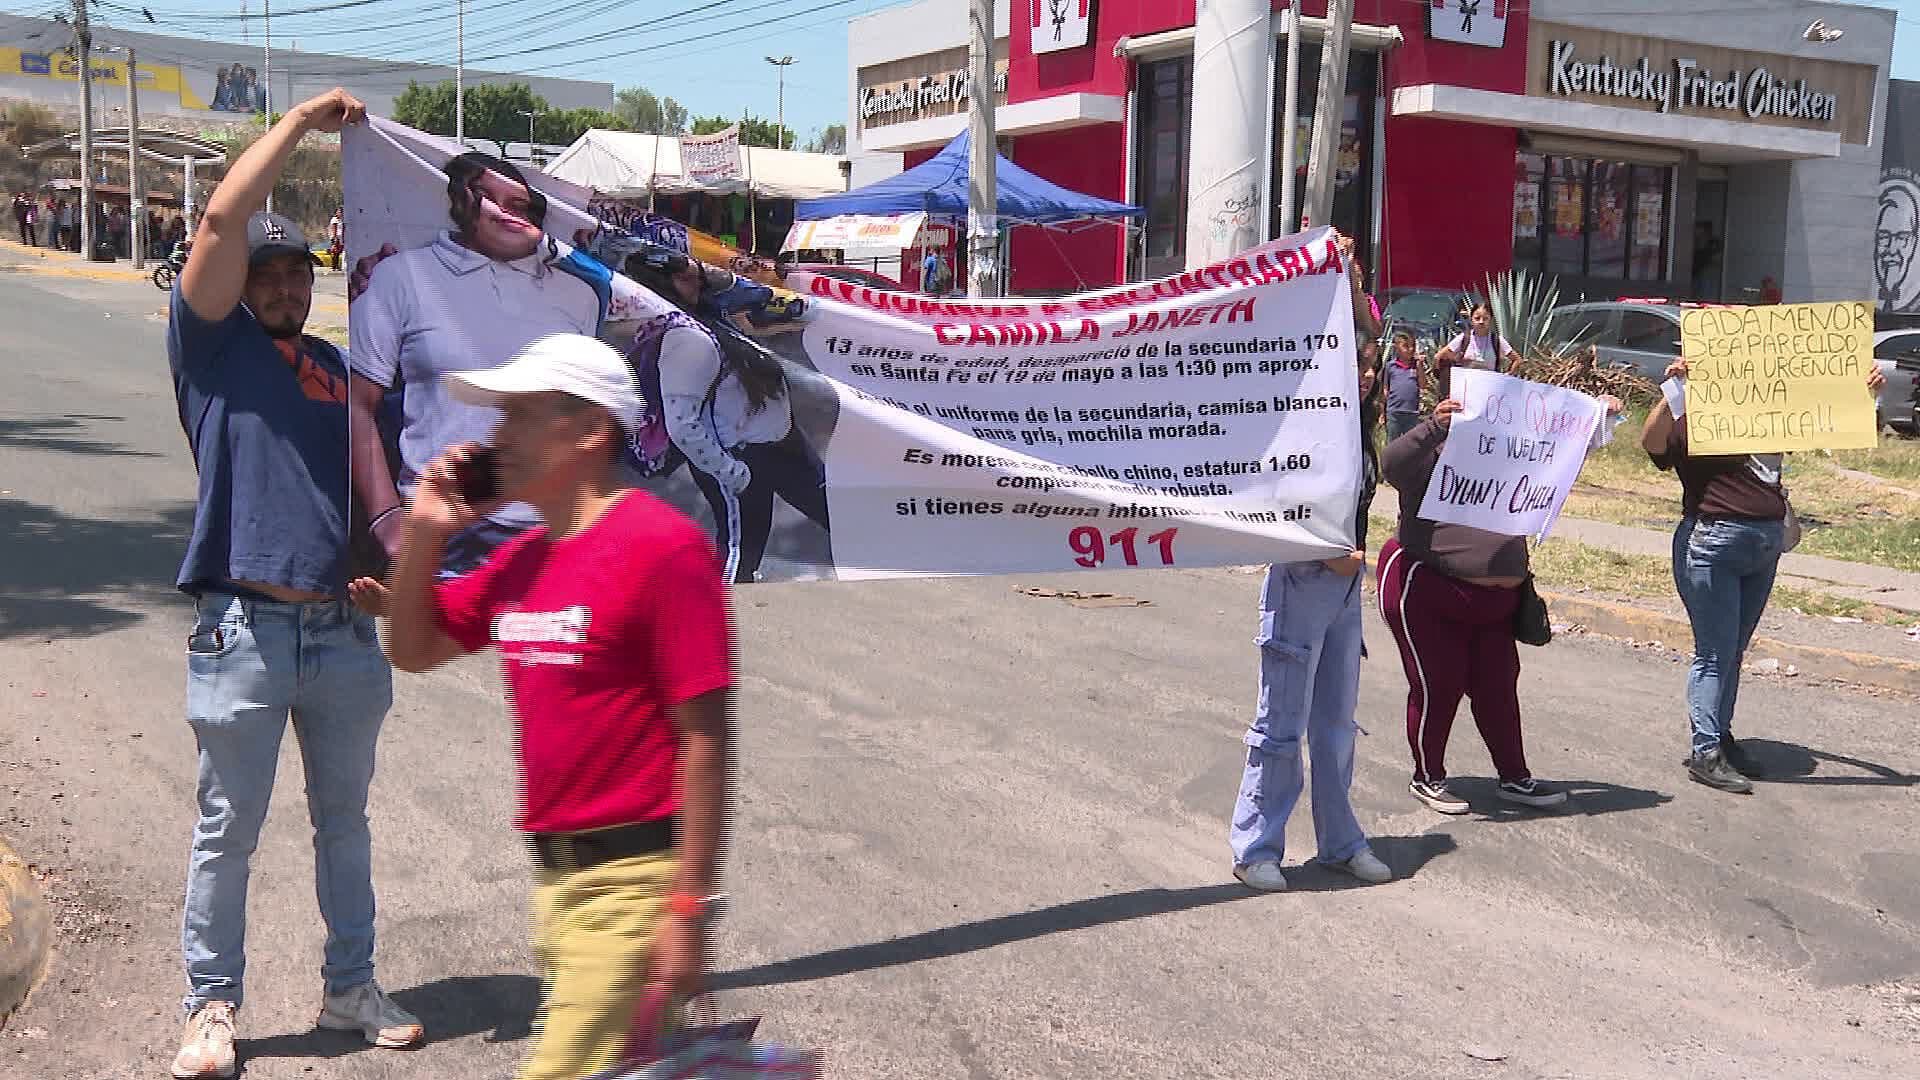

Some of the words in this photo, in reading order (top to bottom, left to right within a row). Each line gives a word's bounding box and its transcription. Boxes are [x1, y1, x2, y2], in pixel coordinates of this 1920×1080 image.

[1550, 40, 1671, 114] Kentucky
[1676, 59, 1741, 109] Fried
[1744, 66, 1837, 120] Chicken
[860, 83, 917, 120] Kentucky
[918, 75, 951, 110] Fried
[933, 319, 1101, 348] CAMILA
[1112, 297, 1256, 338] JANETH
[1682, 308, 1761, 336] CADA
[1770, 303, 1867, 332] MENOR
[825, 337, 853, 354] 13
[919, 352, 949, 364] de
[1135, 342, 1158, 358] de
[1165, 341, 1181, 356] la
[1188, 337, 1297, 356] secundaria
[1303, 334, 1339, 350] 170
[1683, 334, 1858, 358] DESAPARECIDO
[850, 363, 876, 379] en
[879, 362, 939, 383] Santa
[945, 368, 971, 384] Fe
[979, 368, 996, 384] el
[1031, 368, 1056, 384] de
[1062, 364, 1115, 384] mayo
[1121, 364, 1133, 380] a
[1139, 362, 1169, 378] las
[1175, 360, 1217, 376] 1:30
[1222, 361, 1252, 379] pm
[1258, 359, 1320, 376] aprox.
[1686, 360, 1710, 381] ES
[1716, 360, 1755, 380] UNA
[1763, 355, 1859, 379] URGENCIA
[1689, 381, 1722, 405] NO
[1731, 379, 1788, 405] UNA
[935, 403, 1019, 424] uniforme
[1025, 406, 1049, 423] de
[1055, 406, 1073, 421] la
[1079, 402, 1192, 421] secundaria,
[1198, 400, 1268, 416] camisa
[1273, 395, 1348, 412] blanca,
[1021, 425, 1063, 446] gris,
[1067, 424, 1143, 443] mochila
[1149, 421, 1227, 440] morada.
[1478, 433, 1496, 455] DE
[1506, 435, 1557, 465] VUELTA
[903, 448, 934, 465] Es
[1123, 463, 1178, 482] chino,
[1183, 460, 1262, 478] estatura
[1268, 454, 1311, 471] 1.60
[1160, 482, 1233, 497] robusta.
[895, 498, 917, 516] si
[925, 498, 1004, 516] tienes
[1011, 501, 1101, 519] alguna
[1282, 504, 1313, 520] al:
[1068, 525, 1178, 568] 911
